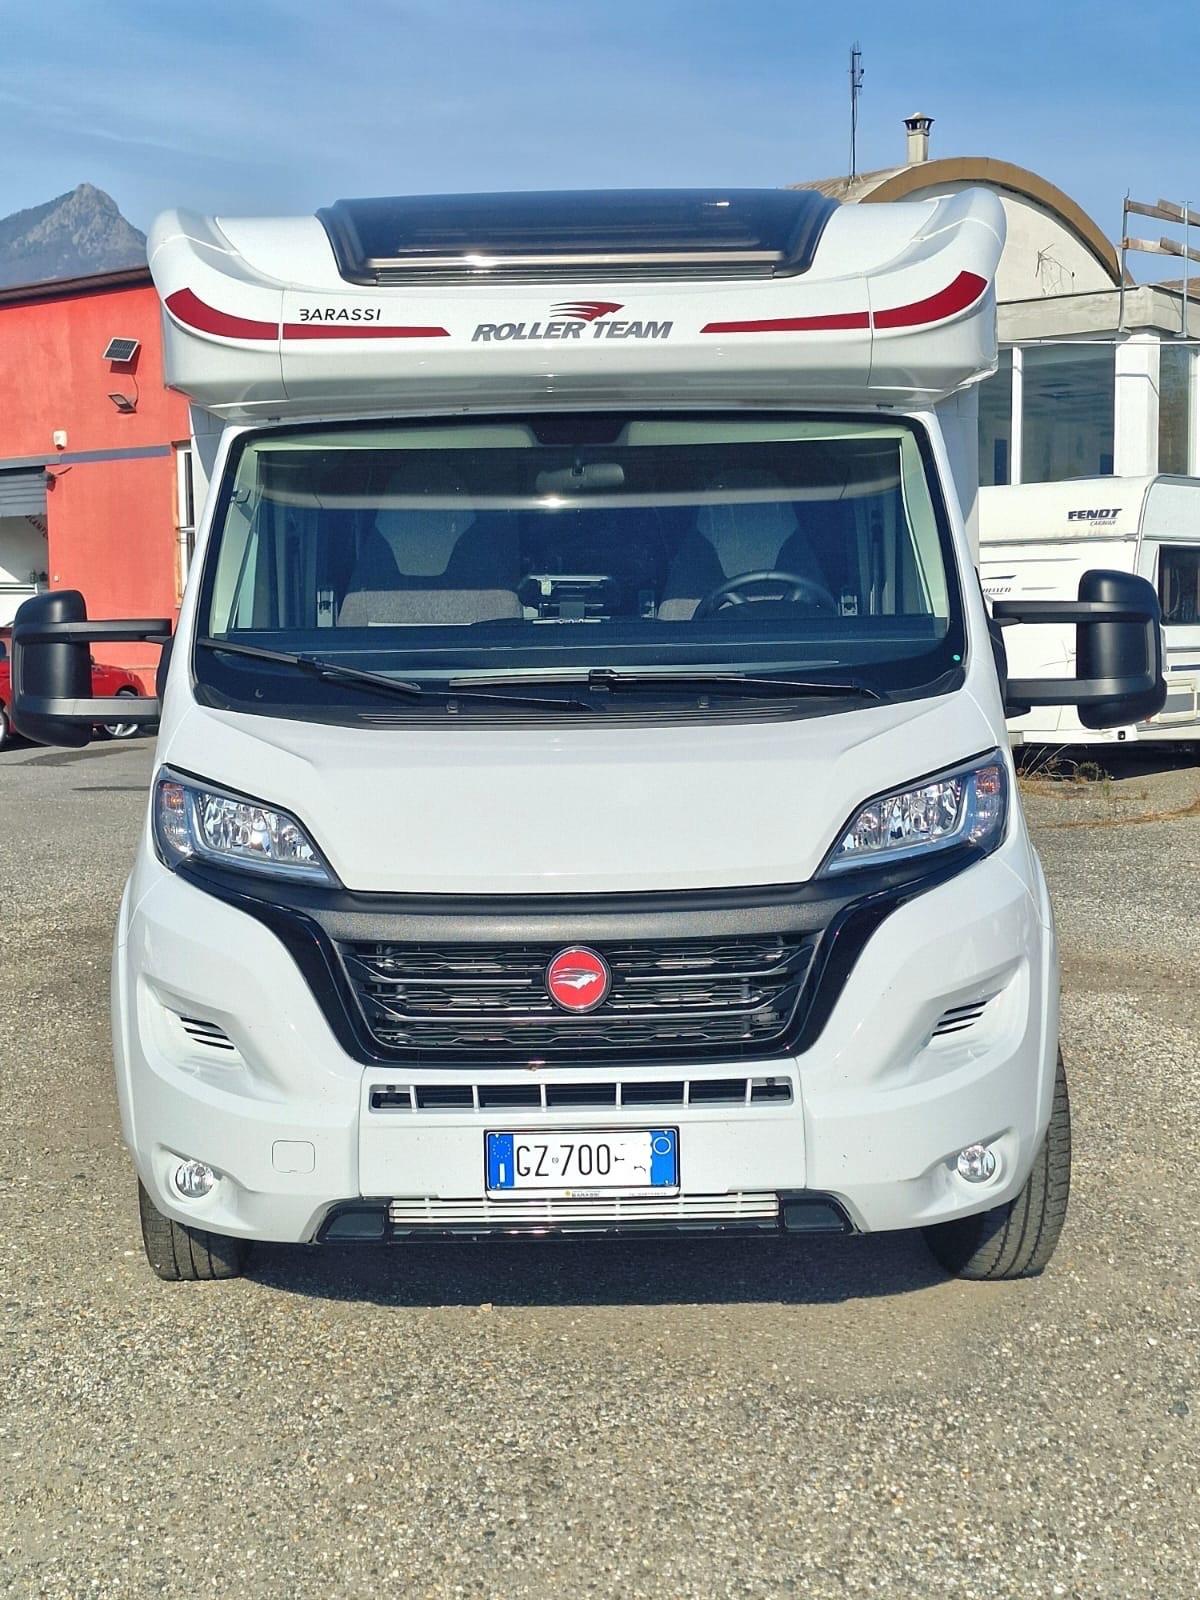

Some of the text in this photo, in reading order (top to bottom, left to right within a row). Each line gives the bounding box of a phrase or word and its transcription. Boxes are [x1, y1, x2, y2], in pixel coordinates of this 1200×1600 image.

[299, 308, 381, 321] BARASSI
[471, 321, 674, 342] ROLLER TEAM
[1068, 508, 1122, 519] FENDT
[517, 1145, 549, 1176] GZ
